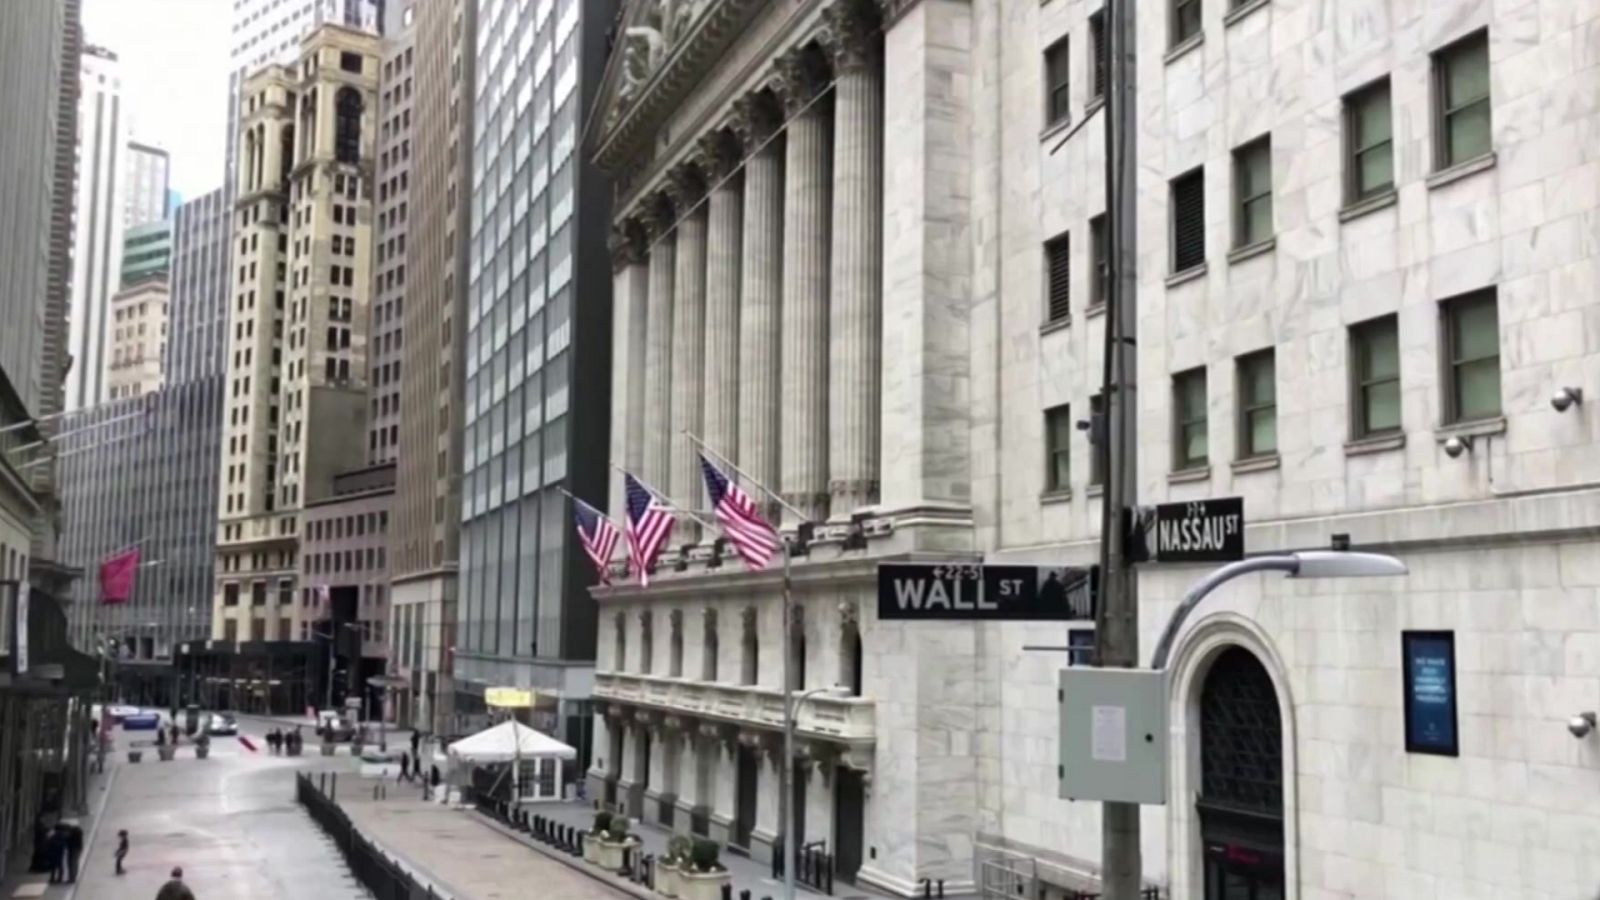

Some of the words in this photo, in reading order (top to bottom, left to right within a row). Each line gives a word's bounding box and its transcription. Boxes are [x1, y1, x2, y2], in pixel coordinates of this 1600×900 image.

[1160, 516, 1224, 551] NASSAU
[1226, 514, 1239, 535] ST
[894, 578, 998, 609] WALL
[1000, 579, 1023, 596] ST
